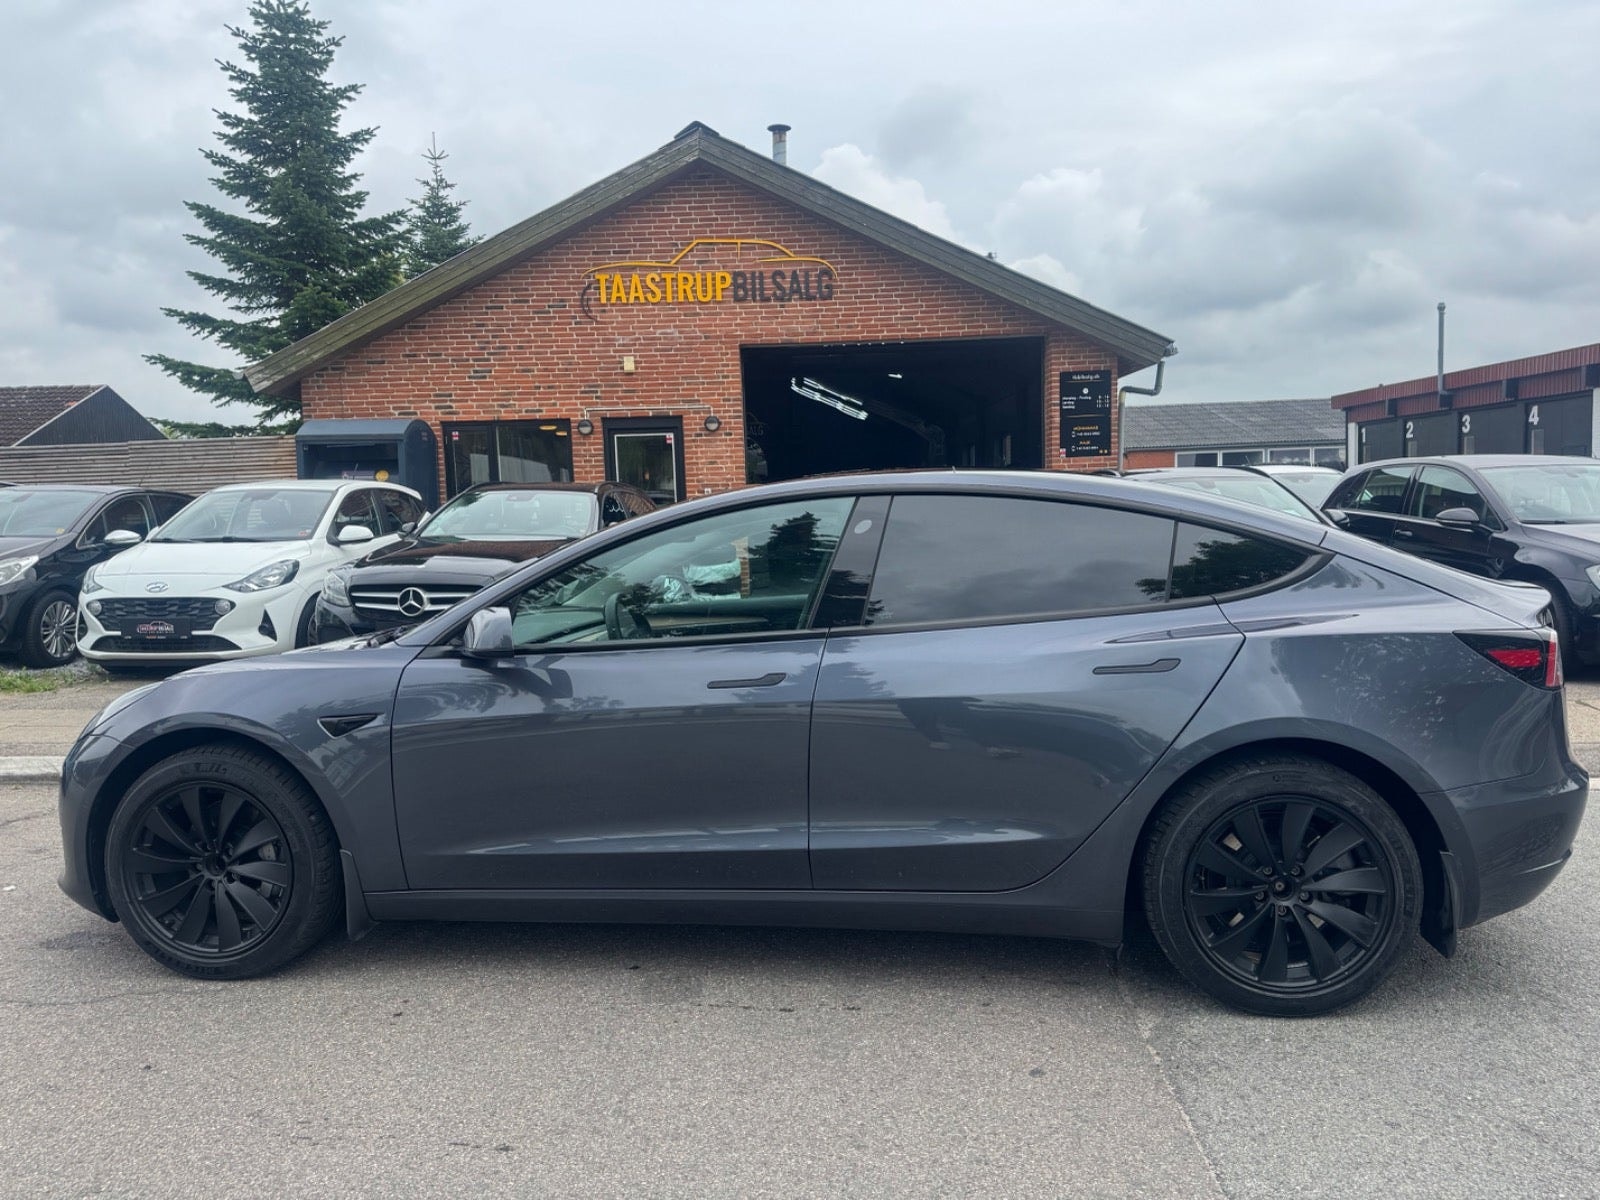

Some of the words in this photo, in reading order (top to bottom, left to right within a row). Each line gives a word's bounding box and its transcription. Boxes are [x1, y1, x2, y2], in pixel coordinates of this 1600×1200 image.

[1462, 414, 1471, 433] 3
[1529, 405, 1540, 425] 4
[1361, 427, 1366, 443] 1
[1405, 421, 1414, 438] 2
